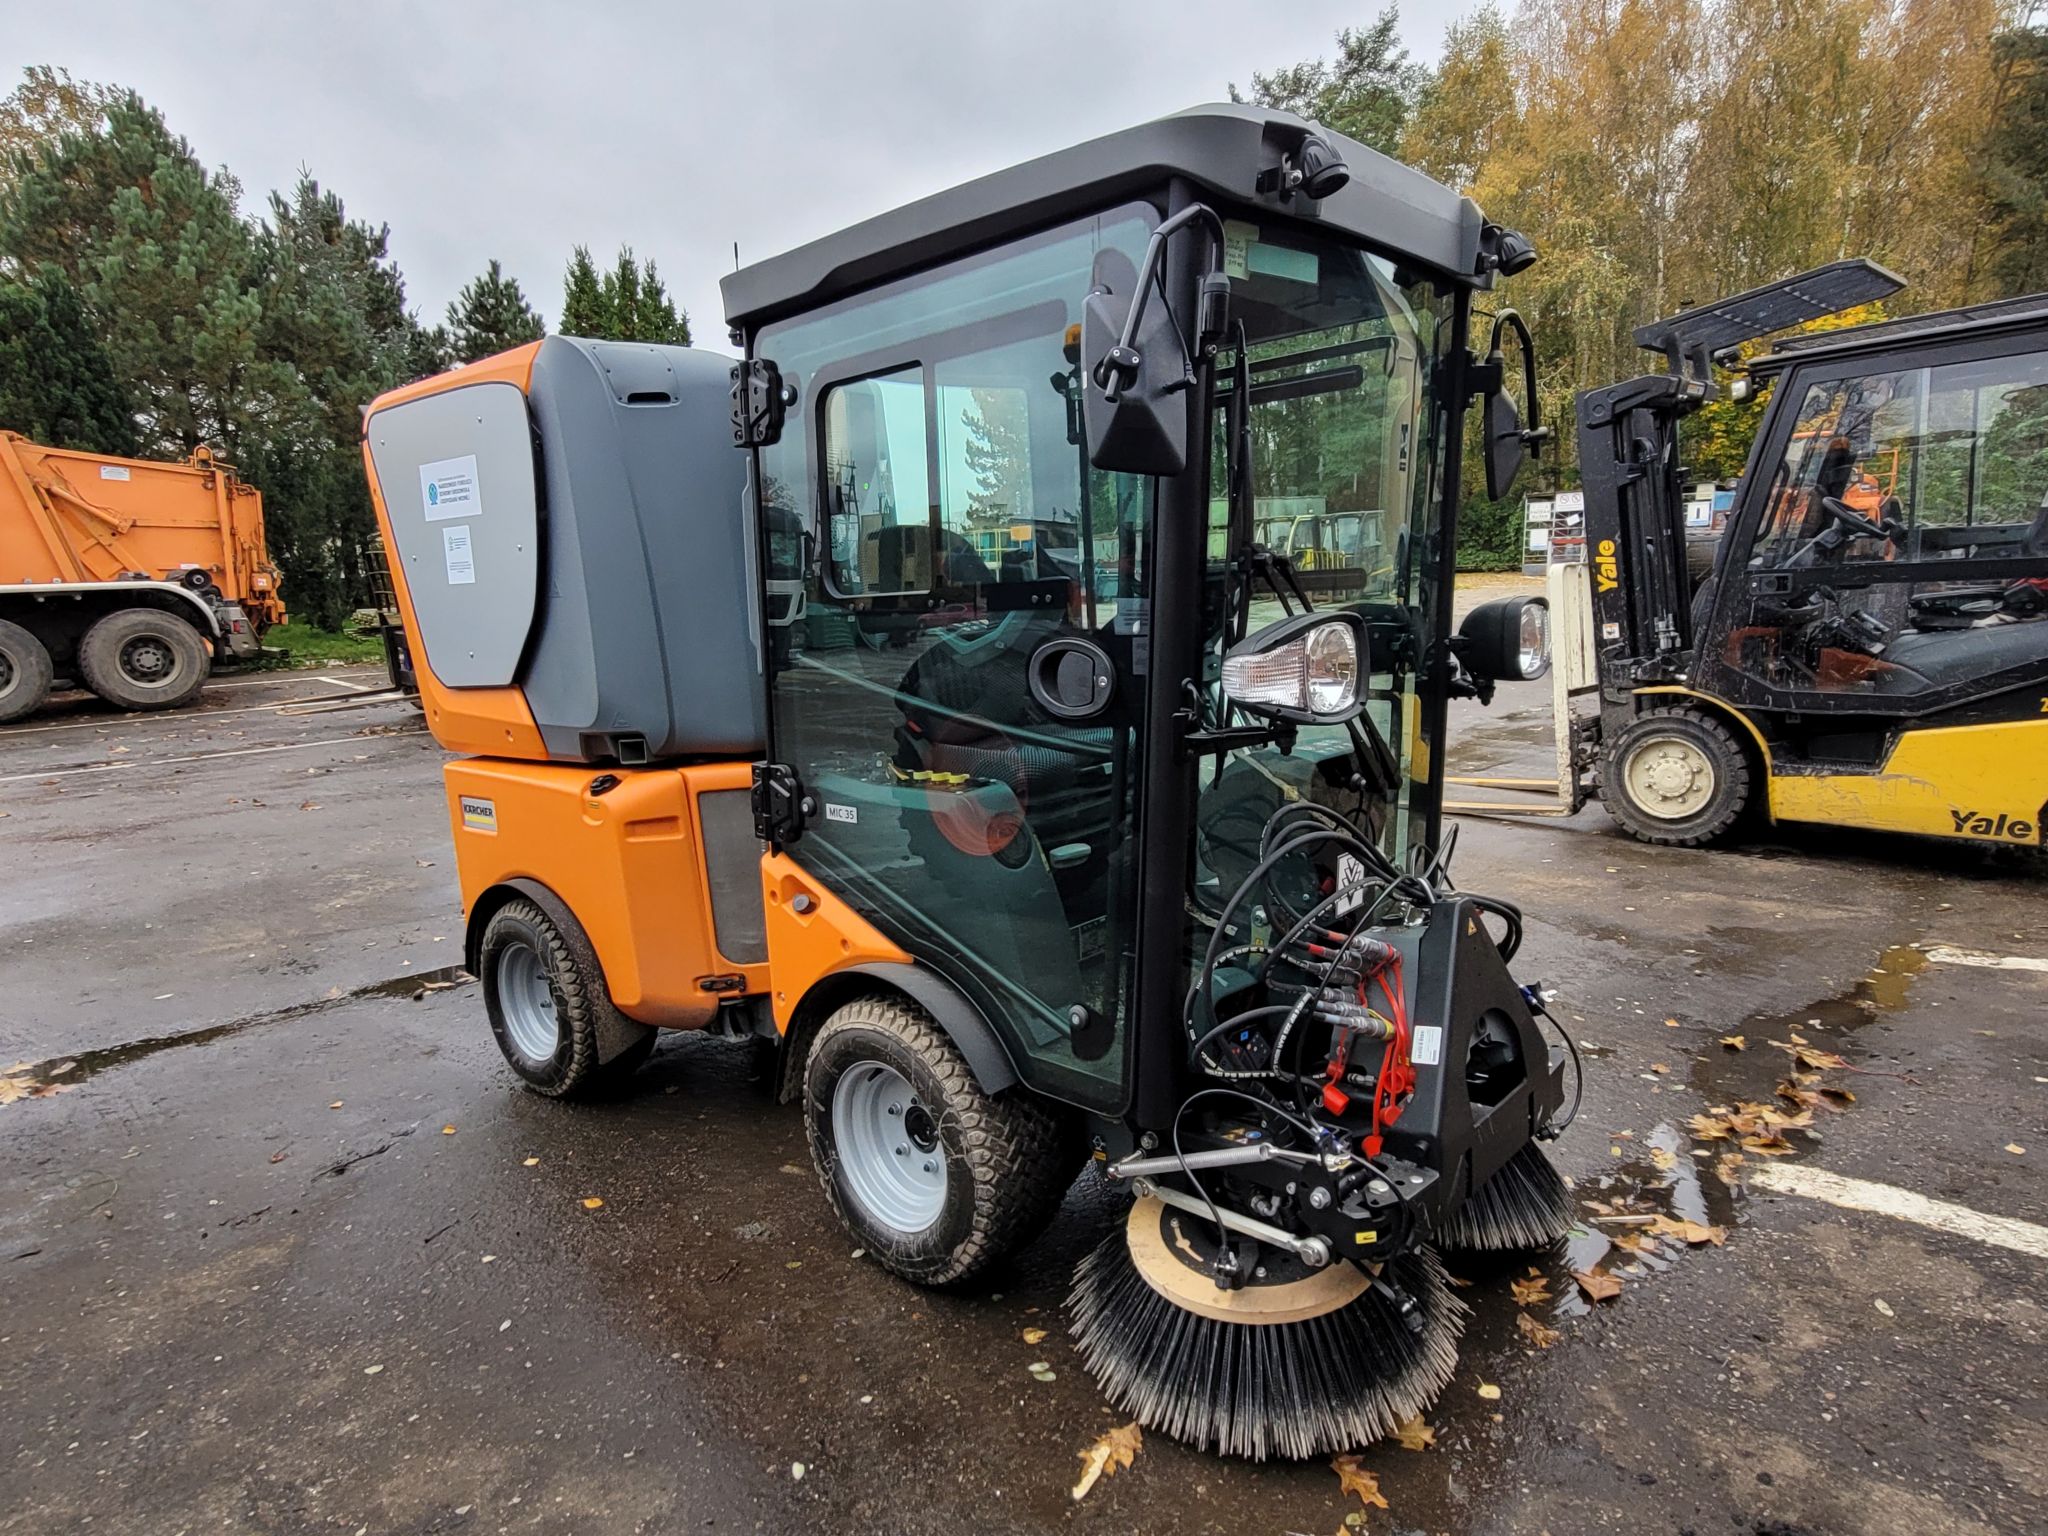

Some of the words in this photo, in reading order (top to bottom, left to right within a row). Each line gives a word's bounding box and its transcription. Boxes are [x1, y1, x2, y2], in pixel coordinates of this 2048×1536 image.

[1596, 540, 1618, 593] Yale
[829, 807, 843, 818] MIC
[845, 809, 855, 820] 35
[1951, 809, 2033, 839] Yale
